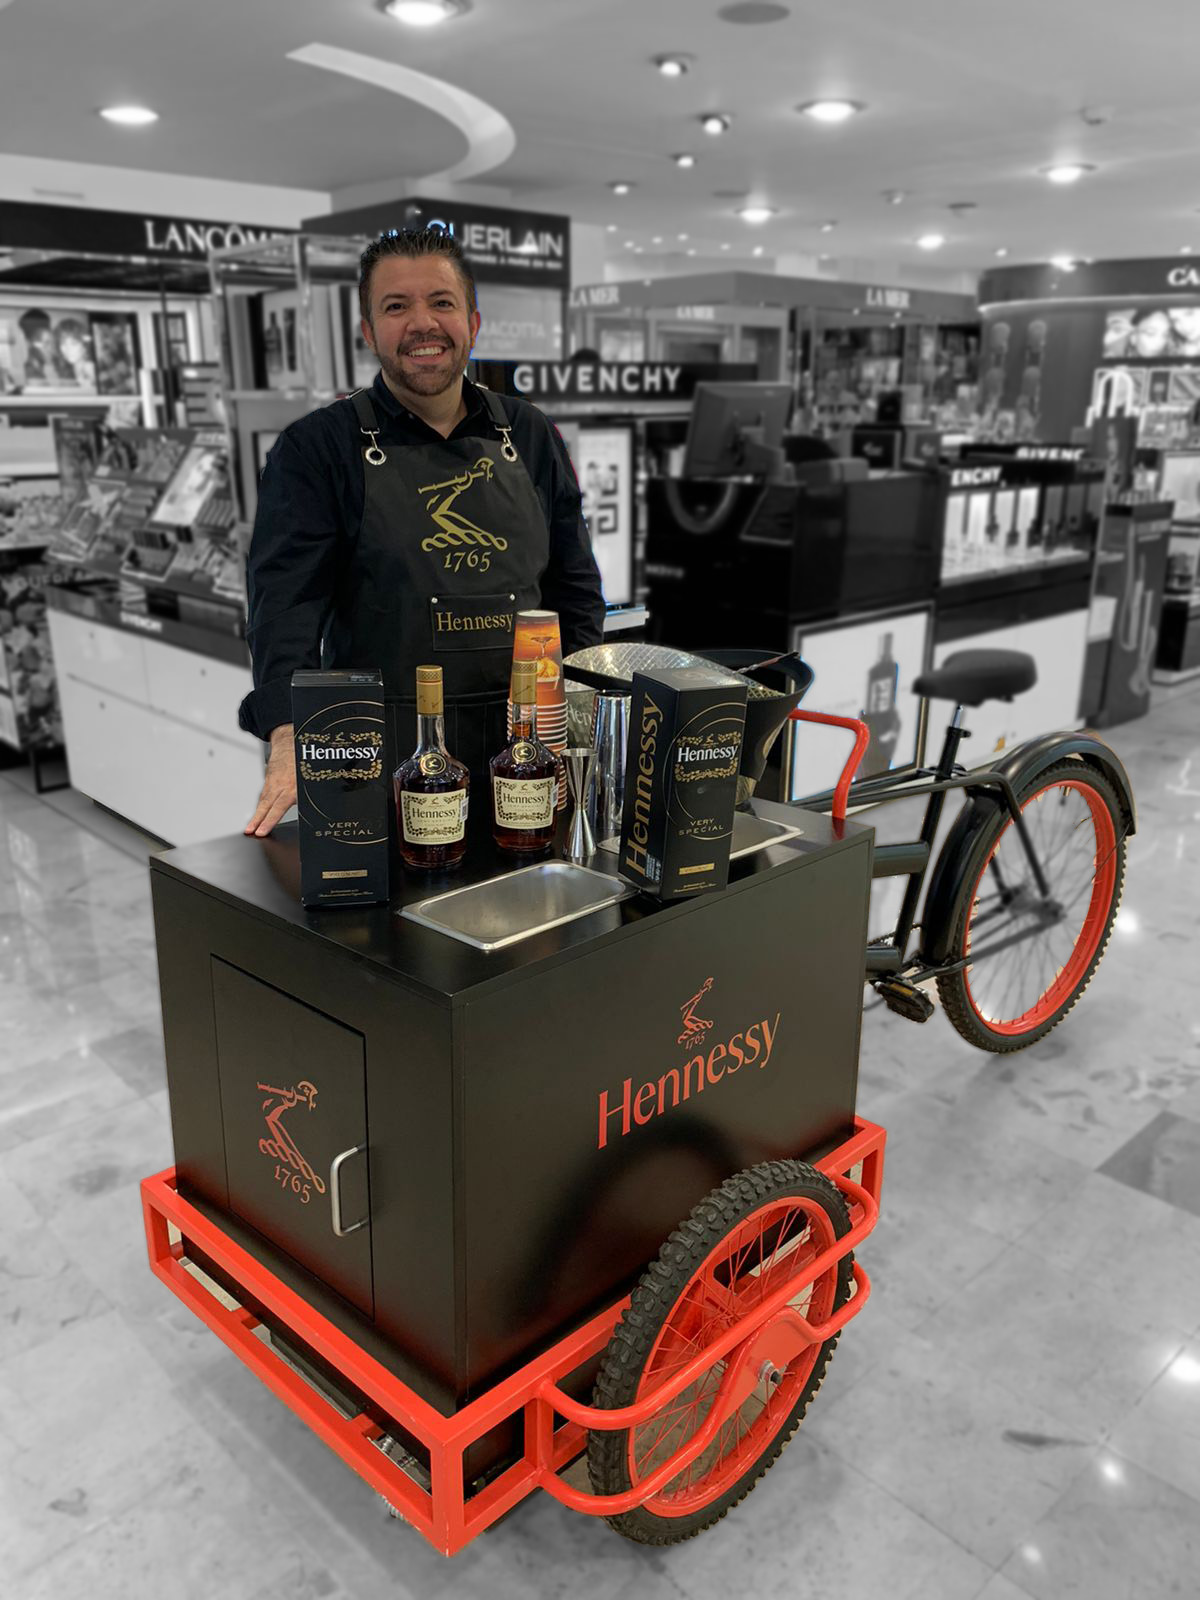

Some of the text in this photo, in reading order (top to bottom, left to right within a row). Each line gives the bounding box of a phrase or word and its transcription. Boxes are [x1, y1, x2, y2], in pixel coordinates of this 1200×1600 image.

[513, 364, 682, 394] GIVENCHY
[1016, 447, 1084, 461] GIVENC
[951, 466, 1003, 487] ENCHY
[444, 549, 491, 573] 1765
[436, 611, 513, 633] Hennessy
[302, 744, 379, 761] Hennessy
[677, 745, 738, 763] Hennessy
[626, 691, 664, 876] Hennessy
[503, 792, 545, 804] Hennessy
[412, 807, 457, 819] Hennessy
[690, 818, 715, 826] VERY
[315, 829, 374, 837] SPECIAL
[328, 821, 359, 829] VERY
[678, 825, 724, 836] SPECIAL
[685, 1031, 705, 1050] 1765
[598, 1012, 781, 1150] Hennessy
[274, 1165, 311, 1204] 1765
